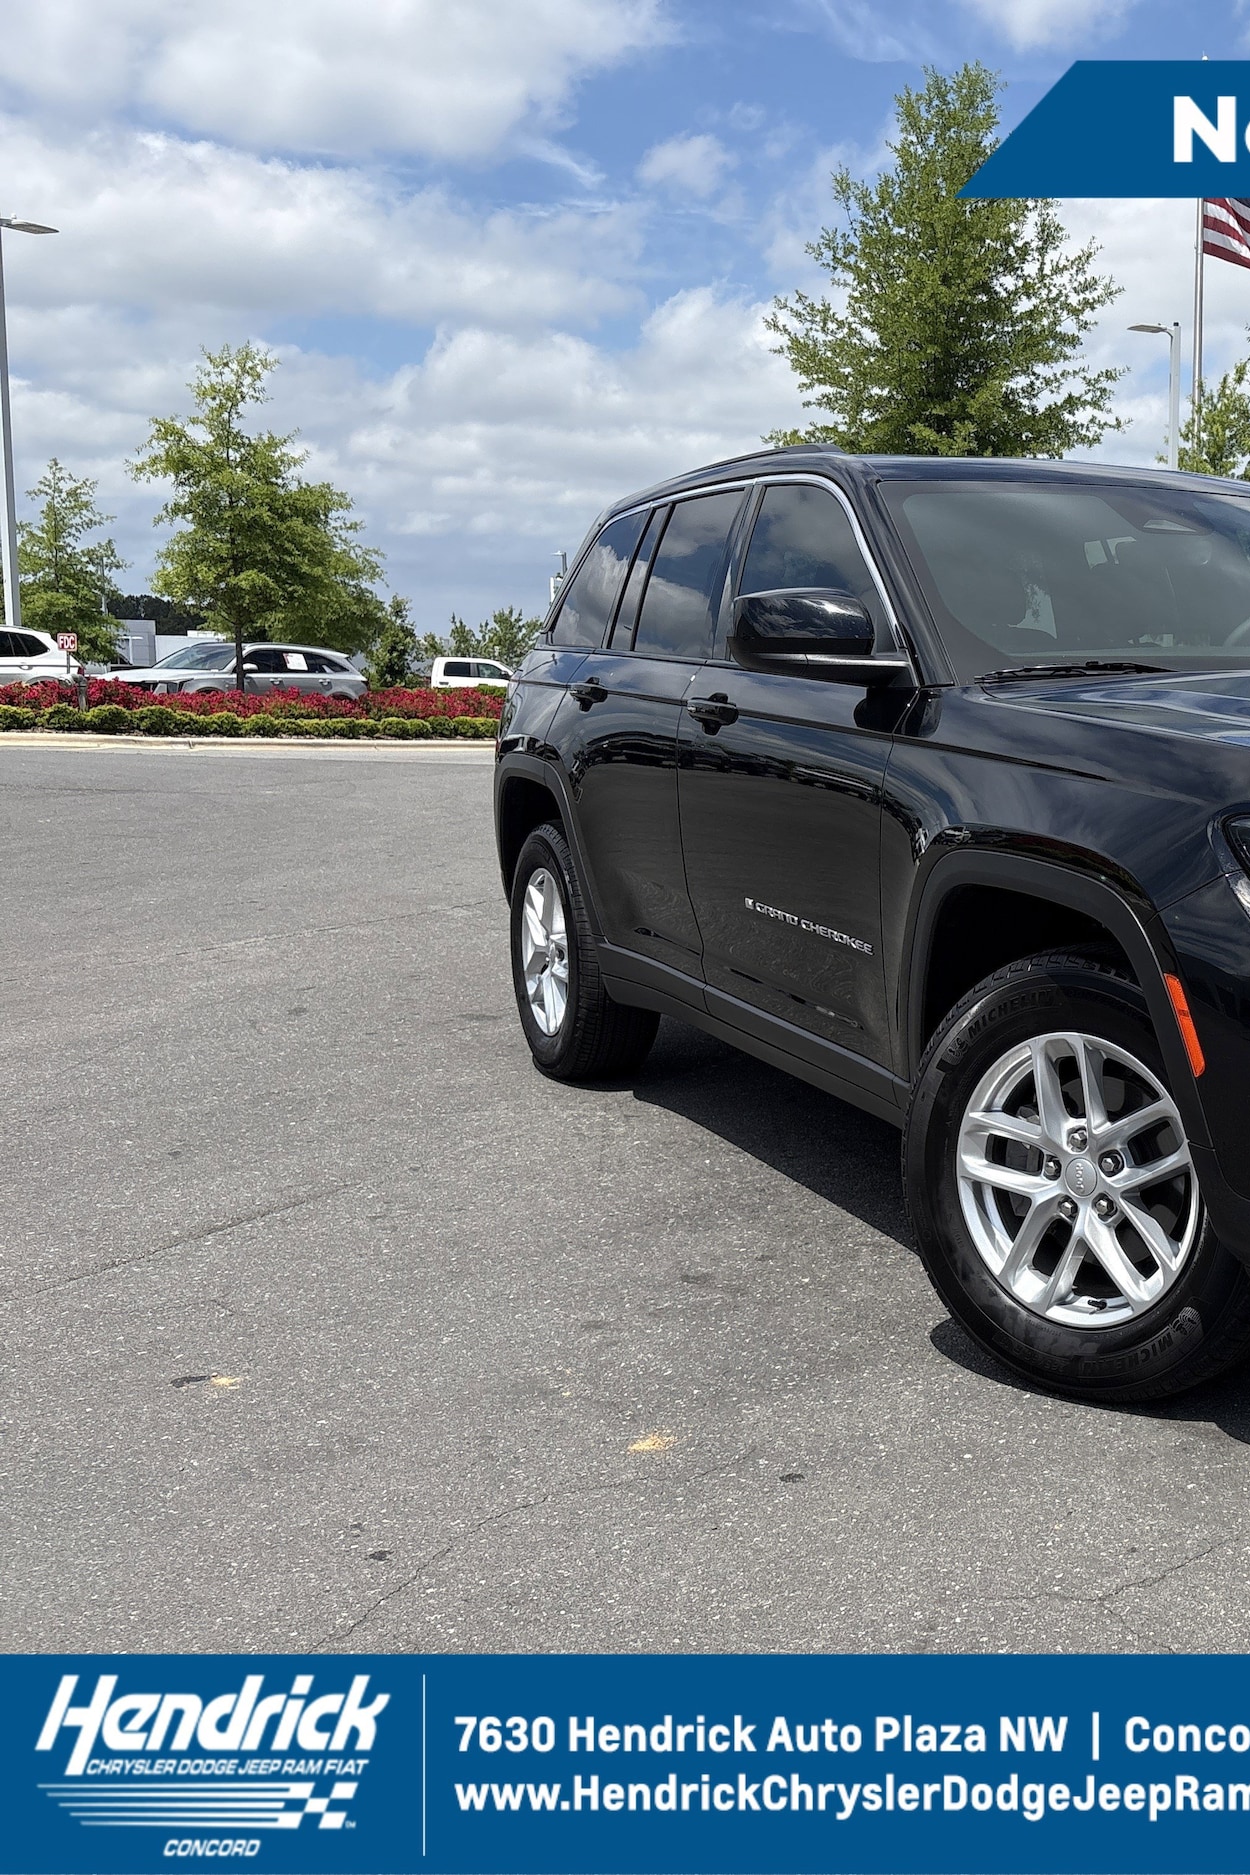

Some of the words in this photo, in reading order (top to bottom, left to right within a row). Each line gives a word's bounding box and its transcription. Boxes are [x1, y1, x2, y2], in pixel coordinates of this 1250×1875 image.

[59, 635, 75, 649] FDC
[755, 902, 799, 926] GRAND
[801, 919, 874, 956] CHEROKEE
